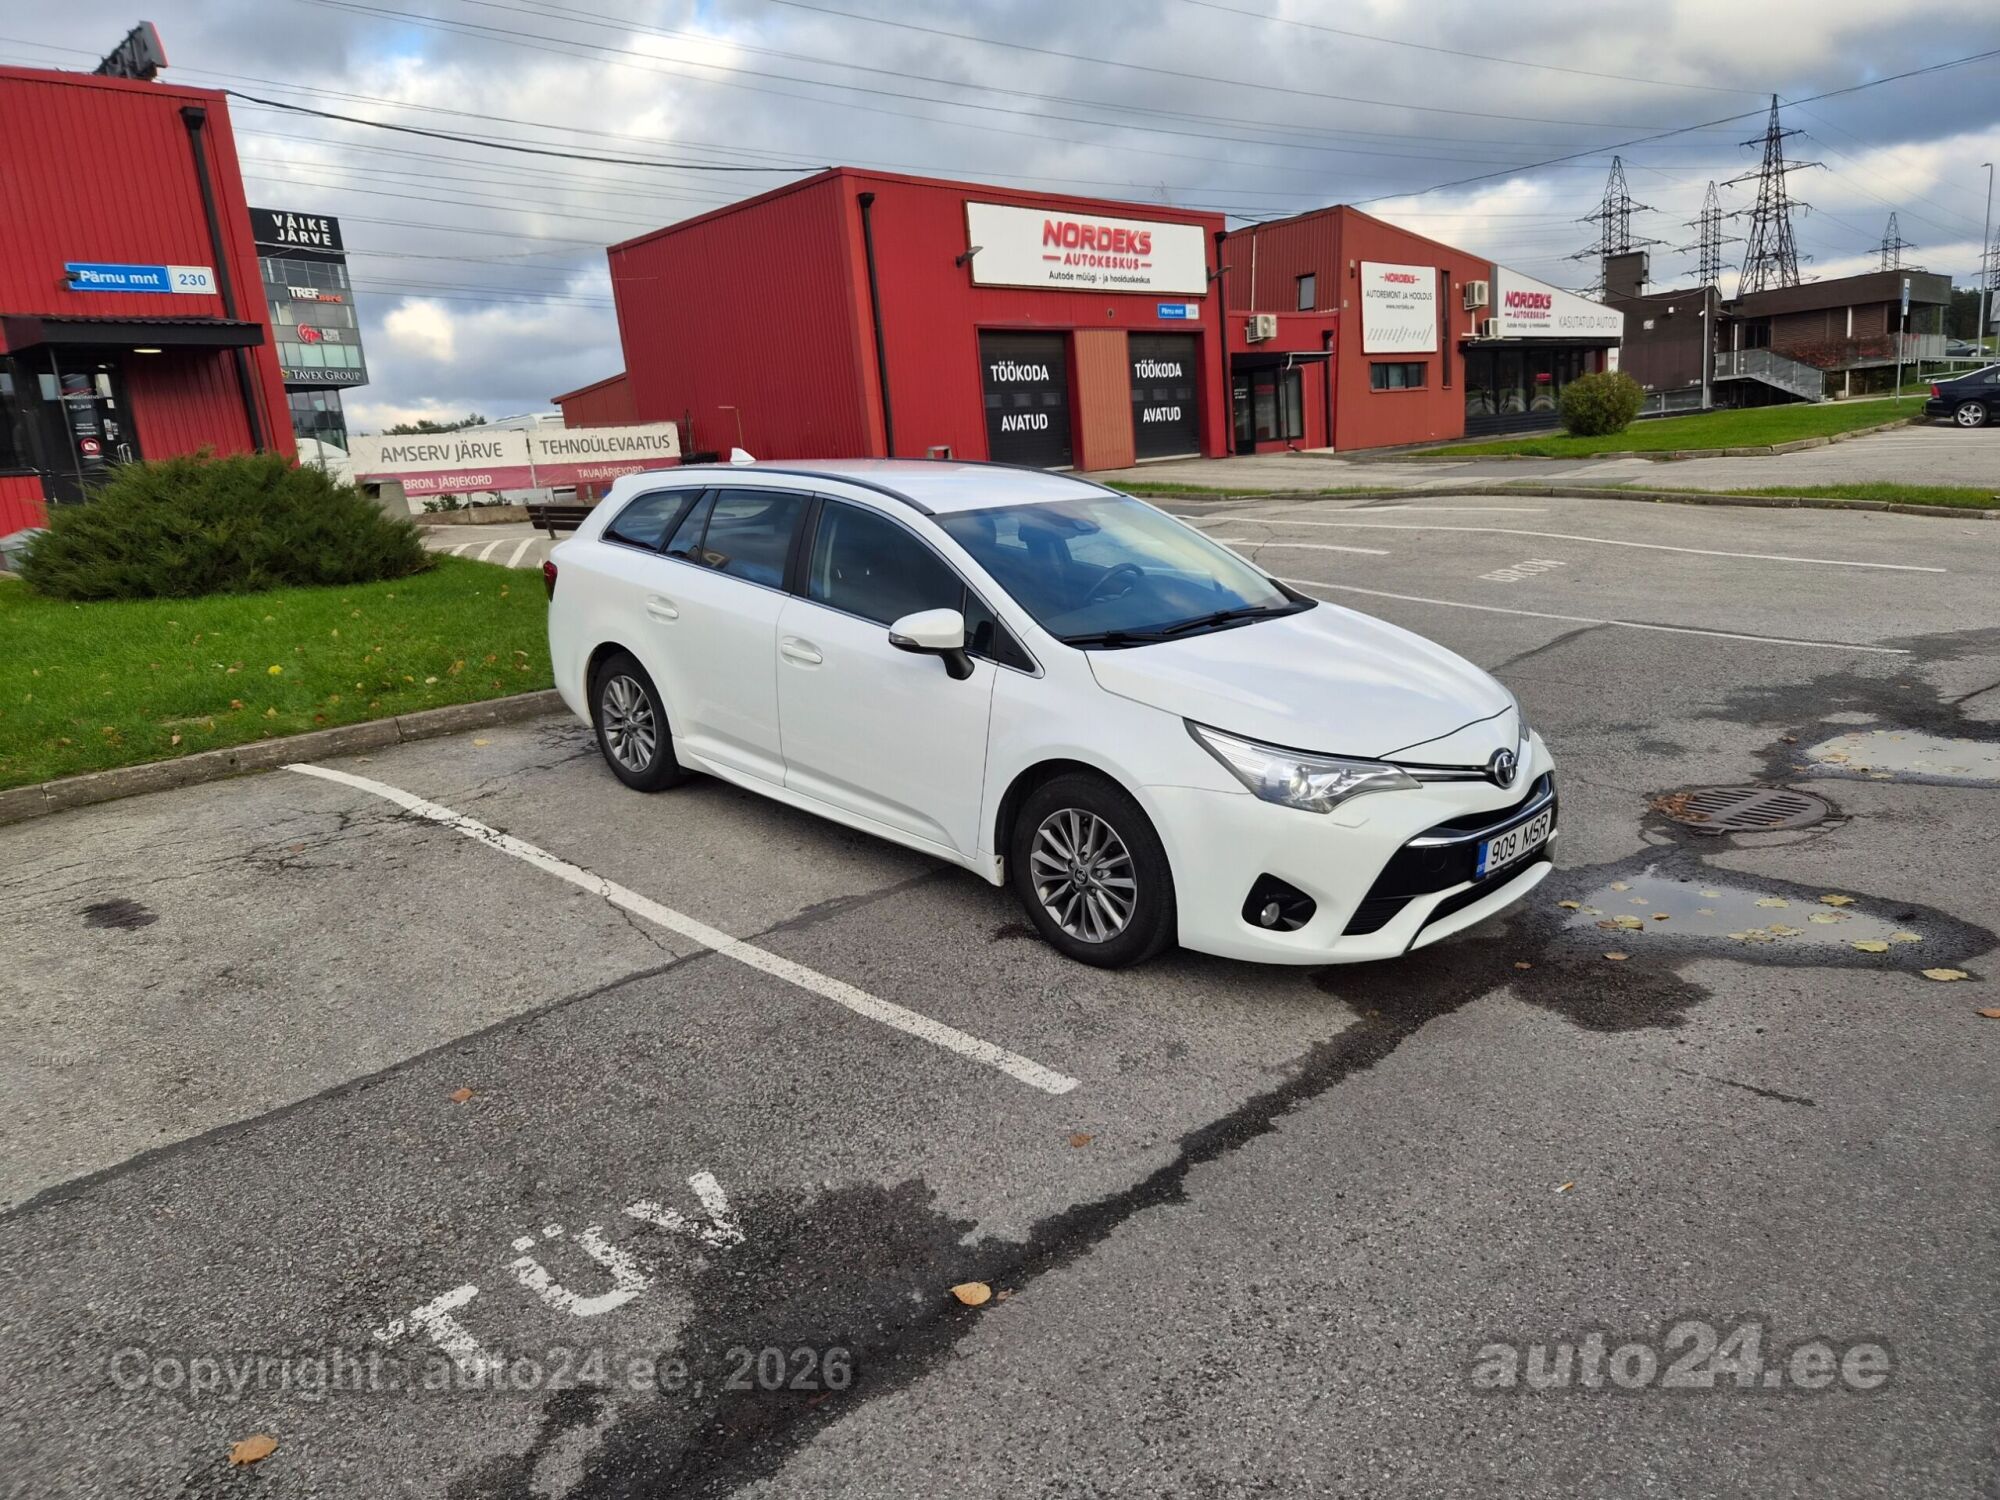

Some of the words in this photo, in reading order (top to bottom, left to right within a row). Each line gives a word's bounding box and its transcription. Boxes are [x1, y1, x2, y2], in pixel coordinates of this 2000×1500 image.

[272, 213, 329, 233] VÄIKE
[276, 228, 332, 246] JÄRVE
[1042, 219, 1152, 256] NORDEKS
[1063, 252, 1140, 270] AUTOKESKUS
[79, 270, 125, 284] Pärnu
[129, 274, 160, 285] mnt
[178, 273, 207, 287] 230
[1048, 270, 1074, 281] Autode
[1076, 272, 1098, 284] müügi
[1110, 275, 1151, 284] hoolduskeskus
[1384, 272, 1416, 284] NORDEKS
[287, 286, 320, 299] TREF
[1366, 289, 1401, 299] AUTOREMONT
[1410, 292, 1433, 301] HOOLDUS
[1504, 291, 1552, 310] NORDEKS
[1559, 315, 1595, 328] KASUTATUD
[1597, 317, 1618, 328] AUTOD
[291, 369, 323, 380] TAVEX
[324, 370, 362, 382] GROUP
[990, 360, 1050, 382] TÖÖKODA
[1134, 359, 1182, 379] TÖÖKODA
[1001, 413, 1048, 432] AVATUD
[1143, 406, 1182, 423] AVATUD
[381, 444, 450, 463] AMSERV
[455, 440, 504, 462] JÄRVE
[539, 434, 670, 455] TEHNOÜLEVAATUS
[402, 479, 437, 490] BRON.
[439, 474, 493, 490] JÄRJEKORD
[1491, 832, 1517, 866] 909
[1521, 813, 1548, 850] MSR
